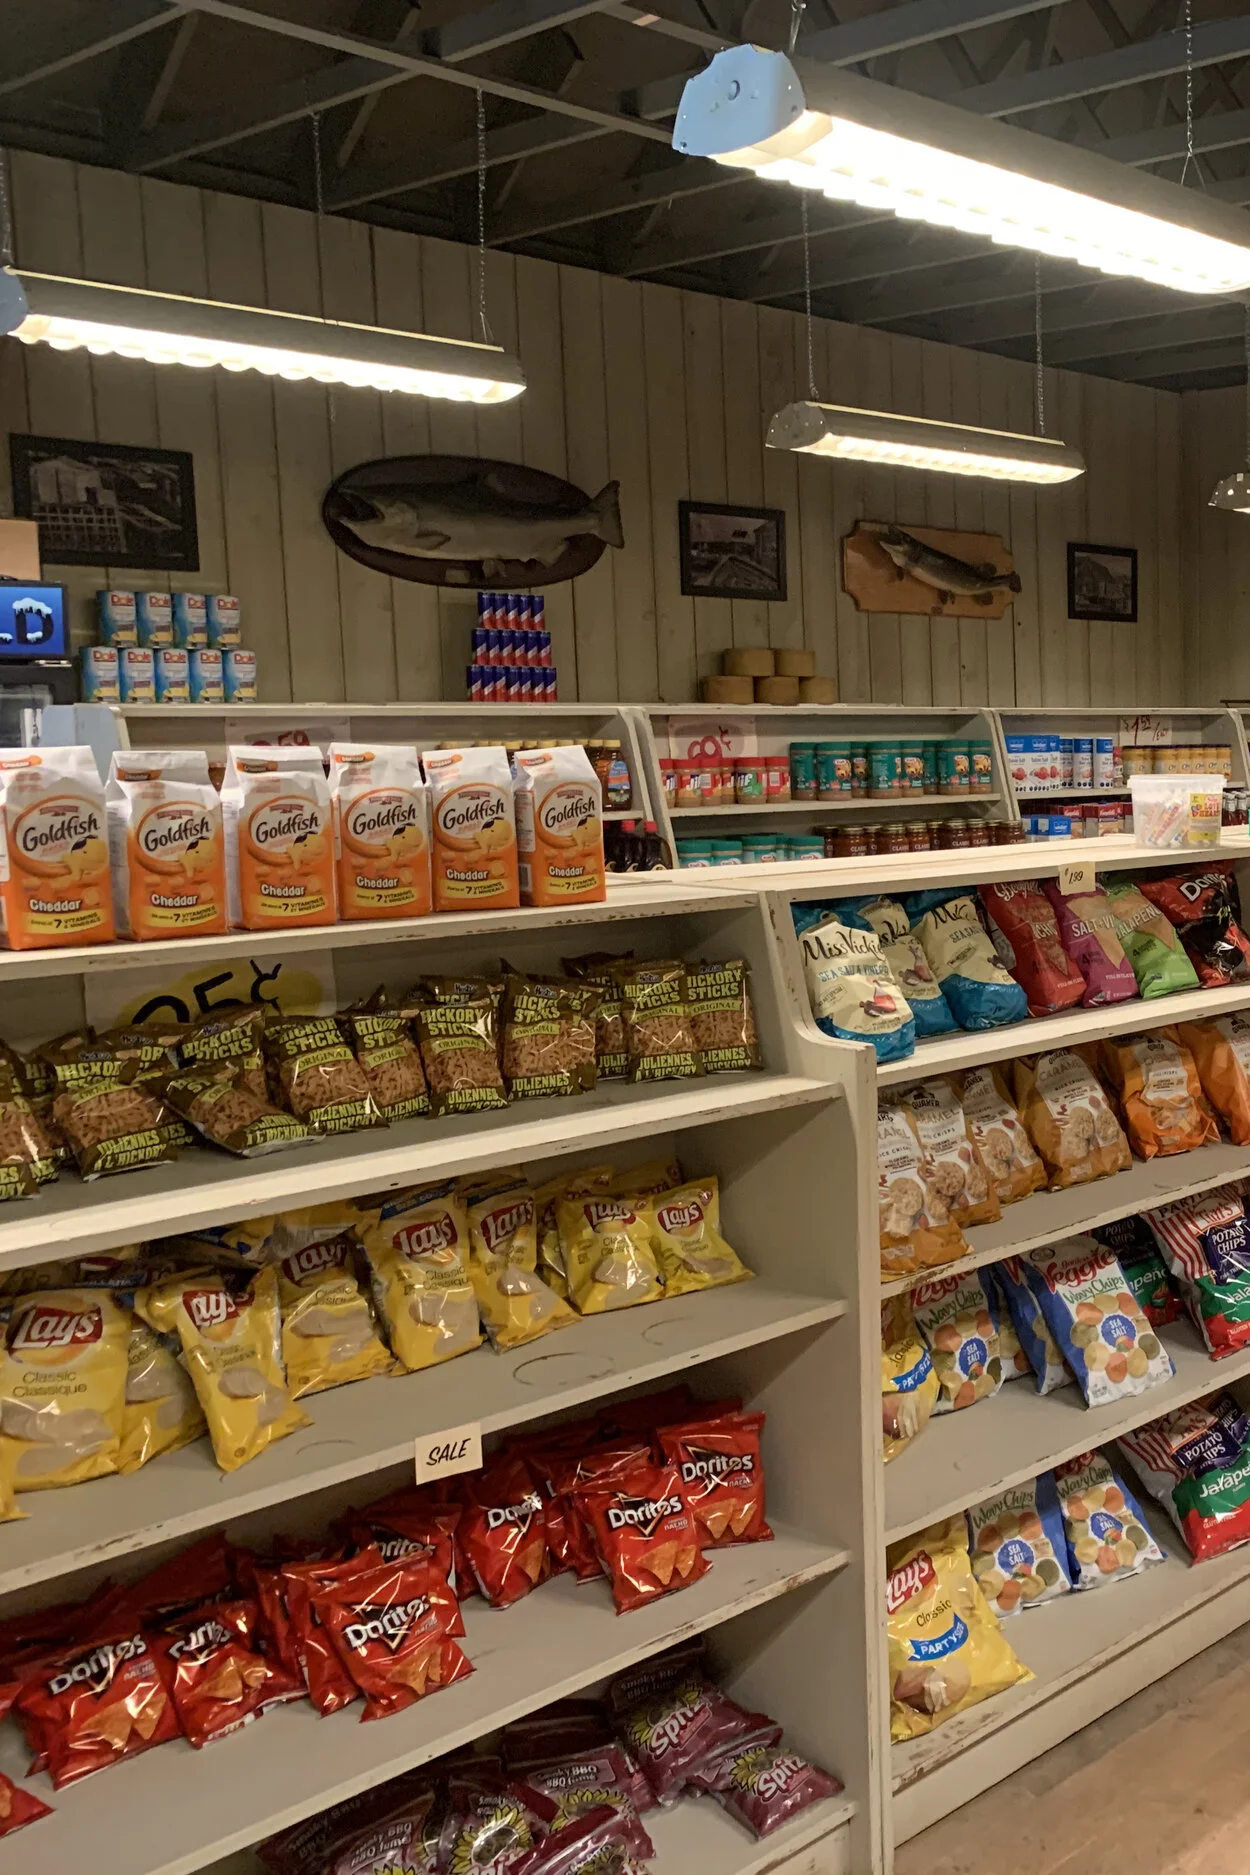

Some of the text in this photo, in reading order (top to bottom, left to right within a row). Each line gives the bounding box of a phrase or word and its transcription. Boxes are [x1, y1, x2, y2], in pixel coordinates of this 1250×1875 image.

[163, 651, 187, 663] Dole
[353, 804, 416, 835] Goldfish
[443, 798, 505, 830] Goldfish
[545, 798, 596, 829] Goldfish
[22, 812, 99, 851] Goldfish
[144, 816, 211, 851] Goldfish
[256, 812, 319, 844] Goldfish
[446, 868, 489, 880] Cheddar
[549, 865, 584, 876] Cheddar
[261, 884, 305, 897] Cheddar
[356, 876, 399, 888] Cheddar
[29, 899, 81, 912] Cheddar
[151, 893, 198, 906] Cheddar
[803, 935, 848, 967] Miss
[687, 968, 742, 988] HICKORY
[820, 968, 837, 982] SEA
[624, 980, 680, 998] HICKORY
[688, 983, 739, 1001] STICKS
[421, 1007, 484, 1023] HICKORY
[693, 1001, 736, 1013] ORIGINAL
[428, 1022, 482, 1036] STICKS
[182, 1023, 253, 1058] HICKORY
[196, 1037, 254, 1061] STICKS
[639, 1053, 694, 1070] JULIENNES
[512, 1073, 570, 1091] JULIENNES
[1111, 1234, 1135, 1247] CHIPS
[1212, 1226, 1245, 1246] POTATO
[1217, 1238, 1247, 1255] CHIPS
[1040, 1247, 1118, 1293] Veggie
[1093, 1275, 1125, 1295] Chips
[956, 1286, 984, 1308] Chips
[1063, 1285, 1095, 1305] Wavy
[921, 1301, 958, 1330] Wavy
[1109, 1319, 1123, 1329] SEA
[1110, 1326, 1127, 1338] SALT
[966, 1343, 978, 1354] SEA
[967, 1351, 981, 1365] SALT
[22, 1371, 77, 1383] Classic
[12, 1382, 88, 1398] Classique
[426, 1437, 471, 1467] SALE
[1184, 1431, 1223, 1461] POTATO
[682, 1455, 753, 1483] Doritos
[1057, 1474, 1090, 1498] Wavy
[1002, 1490, 1035, 1511] Chips
[608, 1495, 683, 1529] Doritos
[973, 1501, 1003, 1528] Wavy
[1100, 1520, 1115, 1532] SALT
[1008, 1543, 1021, 1555] SEA
[1009, 1553, 1025, 1565] SALT
[916, 1599, 952, 1628] Classic
[921, 1633, 958, 1655] PARTY
[48, 1634, 147, 1695] Doritos
[572, 1764, 598, 1775] BBQ
[757, 1755, 807, 1798] Spitz
